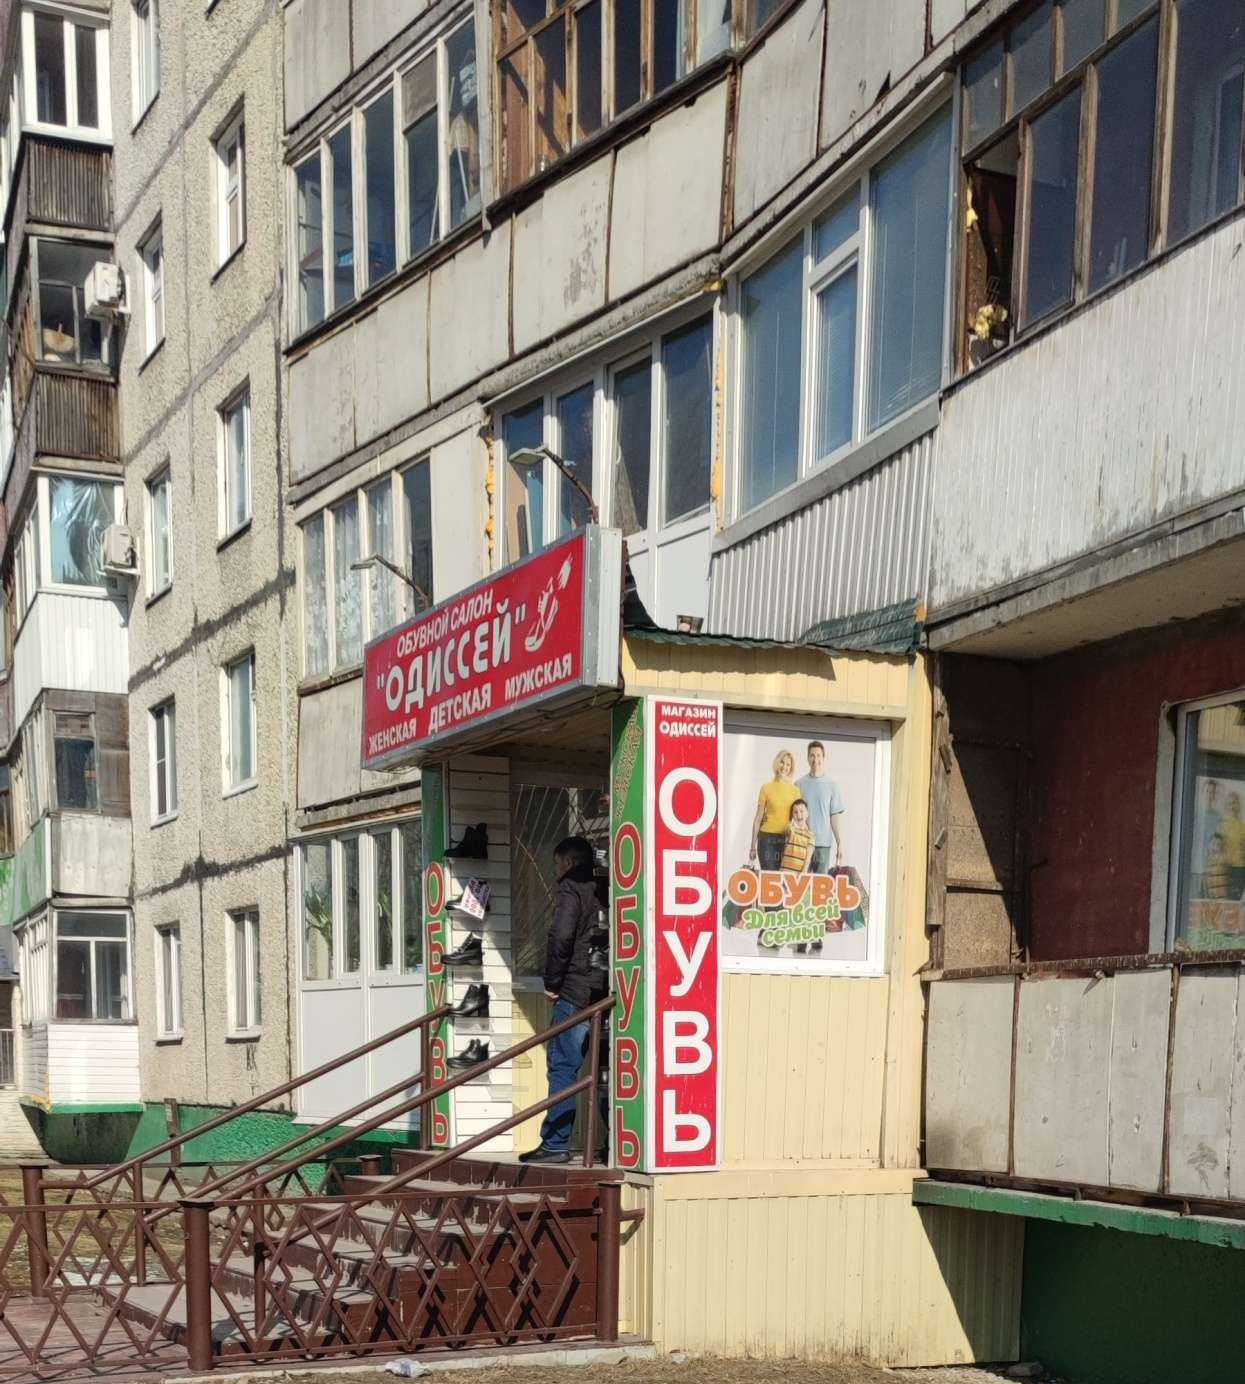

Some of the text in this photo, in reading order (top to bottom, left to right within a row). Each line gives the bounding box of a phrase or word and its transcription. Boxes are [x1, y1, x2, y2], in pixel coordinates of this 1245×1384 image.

[396, 588, 494, 658] ОБУВНОЙ САЛОН
[376, 598, 526, 714] "ОДИССЕЙ"
[368, 653, 572, 755] ЖЕНСКАЯ ДЕТСКАЯ МУЖСКАЯ
[659, 720, 716, 738] ОДИССЕЙ
[661, 704, 716, 719] МАГАЗИН
[728, 868, 861, 911] ОБУВЬ
[742, 897, 841, 930] Для всей
[658, 766, 717, 1153] ОБУВЬ
[762, 922, 826, 947] семьи
[613, 821, 641, 1169] ОБУВЬ
